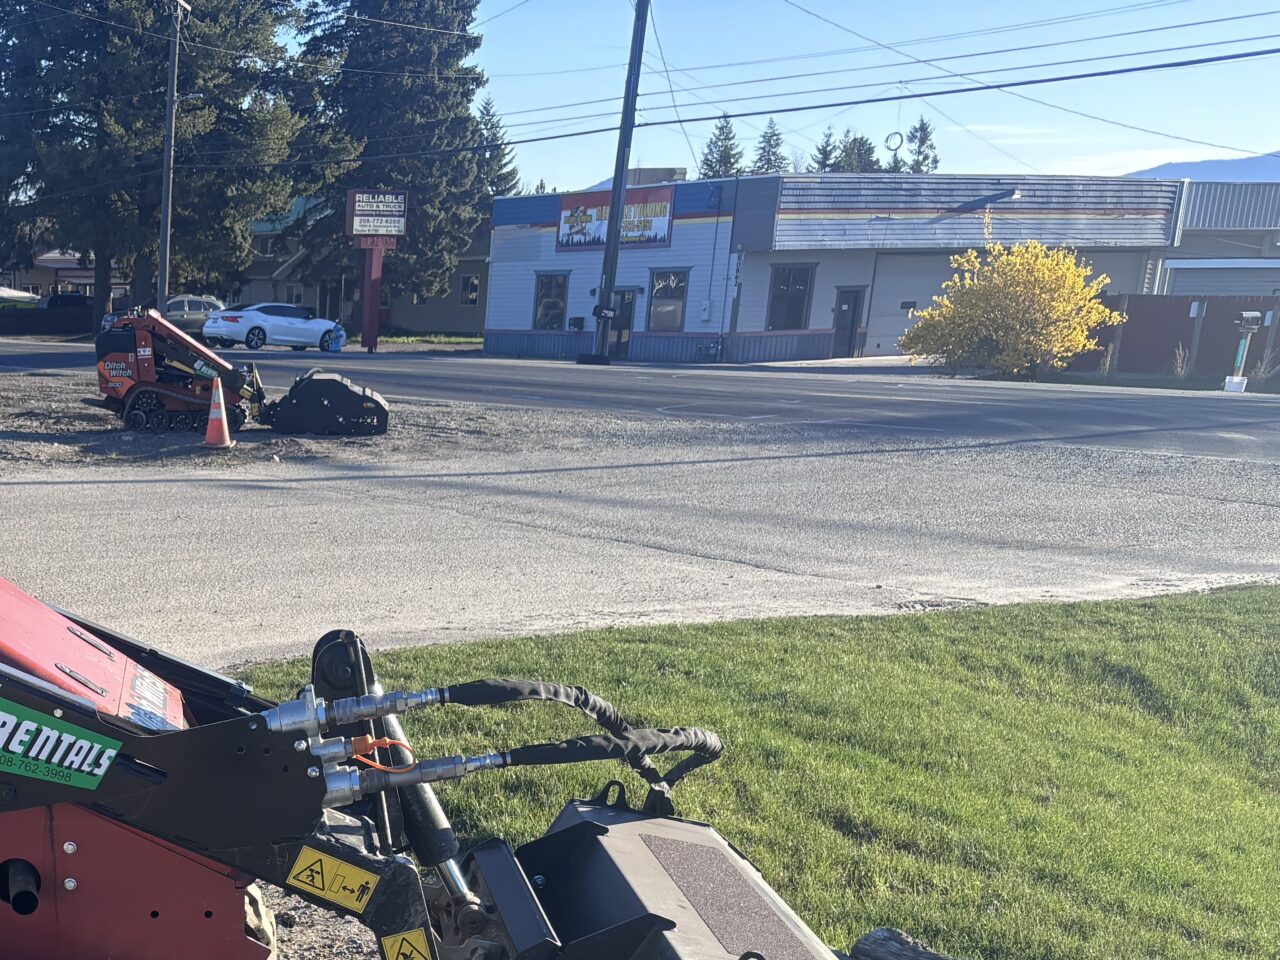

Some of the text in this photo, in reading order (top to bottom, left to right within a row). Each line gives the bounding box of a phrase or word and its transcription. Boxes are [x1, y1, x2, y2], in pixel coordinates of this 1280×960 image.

[356, 194, 404, 202] RELIABLE
[634, 202, 668, 218] TOWING
[105, 362, 126, 370] Ditch
